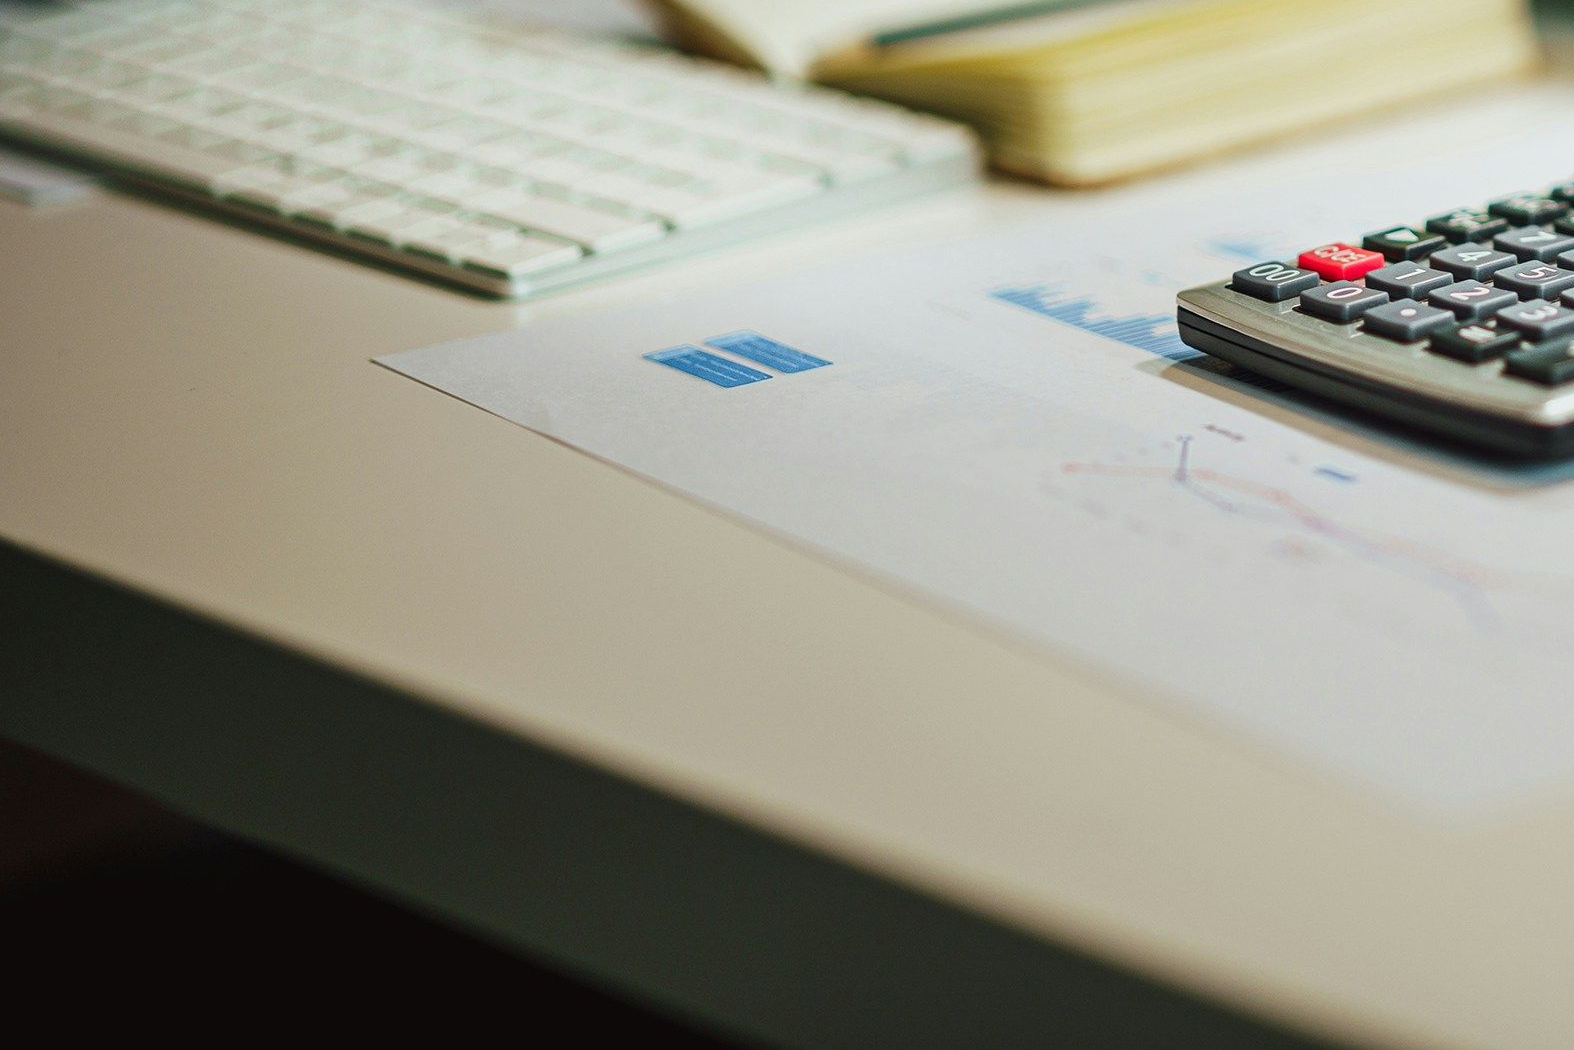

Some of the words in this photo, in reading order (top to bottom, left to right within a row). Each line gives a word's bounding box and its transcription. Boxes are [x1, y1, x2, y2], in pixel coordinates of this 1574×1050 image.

[1519, 231, 1557, 243] 7
[1457, 250, 1492, 262] 4
[1249, 264, 1300, 281] 00
[1395, 268, 1426, 280] 1
[1518, 266, 1557, 279] 5
[1326, 287, 1363, 299] 0
[1450, 287, 1491, 301] 2
[1519, 305, 1559, 321] 3
